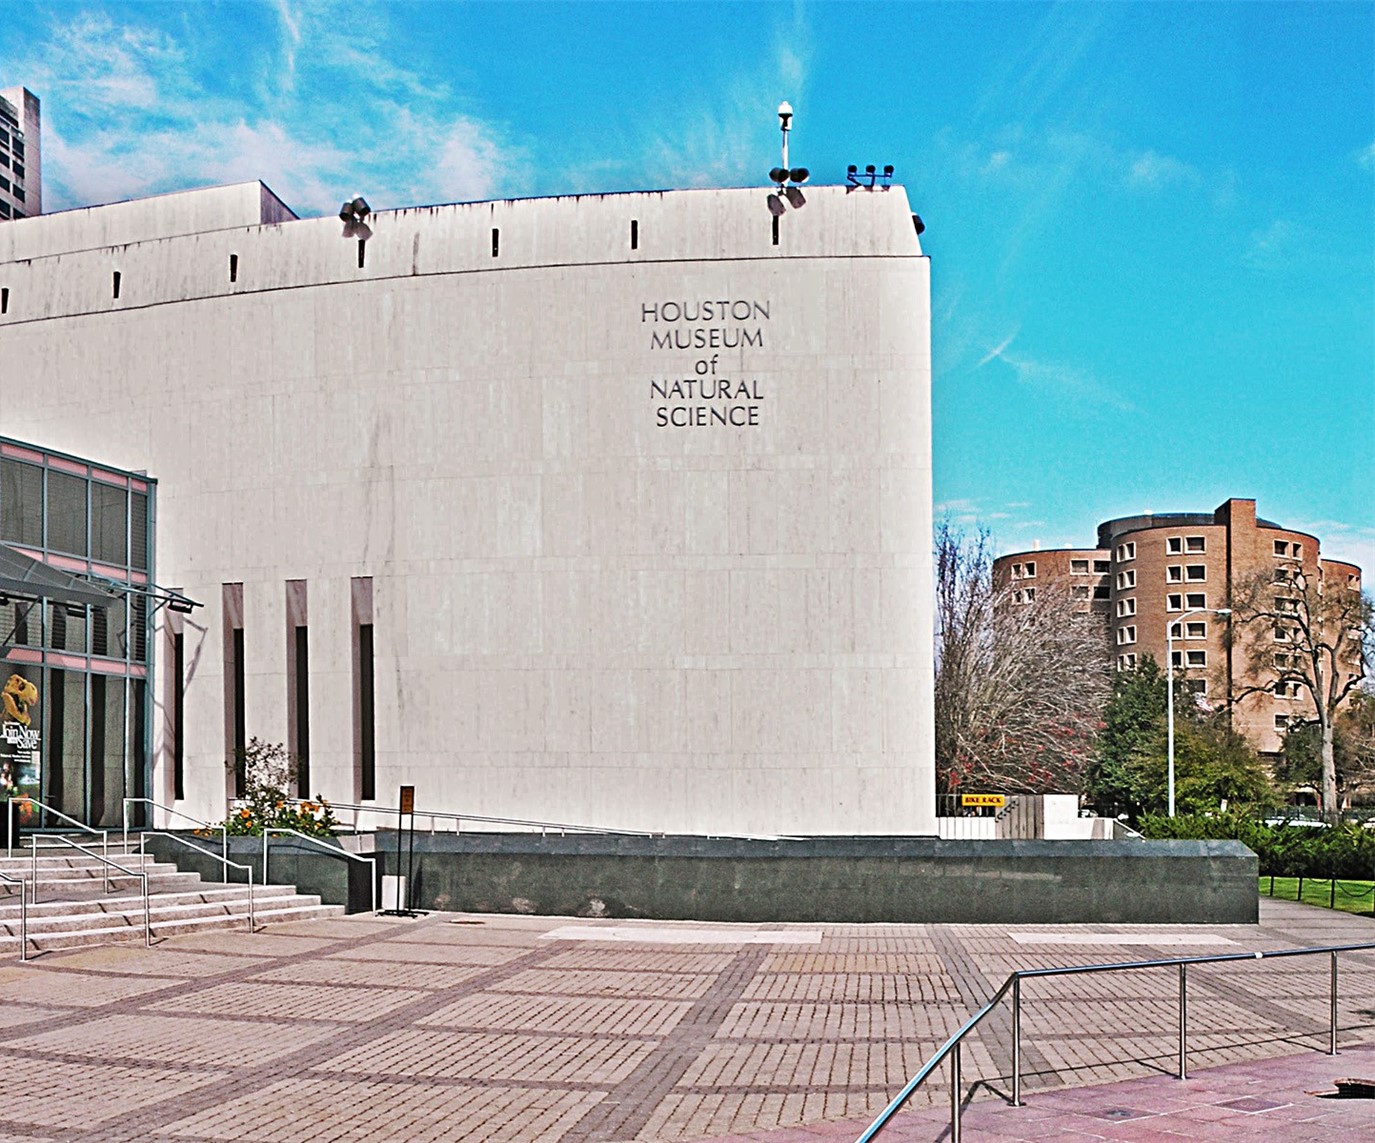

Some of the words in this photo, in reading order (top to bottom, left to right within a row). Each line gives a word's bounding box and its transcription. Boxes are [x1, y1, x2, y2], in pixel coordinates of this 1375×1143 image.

[641, 300, 770, 323] HOUSTON
[650, 328, 763, 350] MUSEUM
[695, 354, 719, 375] of
[650, 379, 764, 400] NATURAL
[656, 406, 759, 427] SCIENCE
